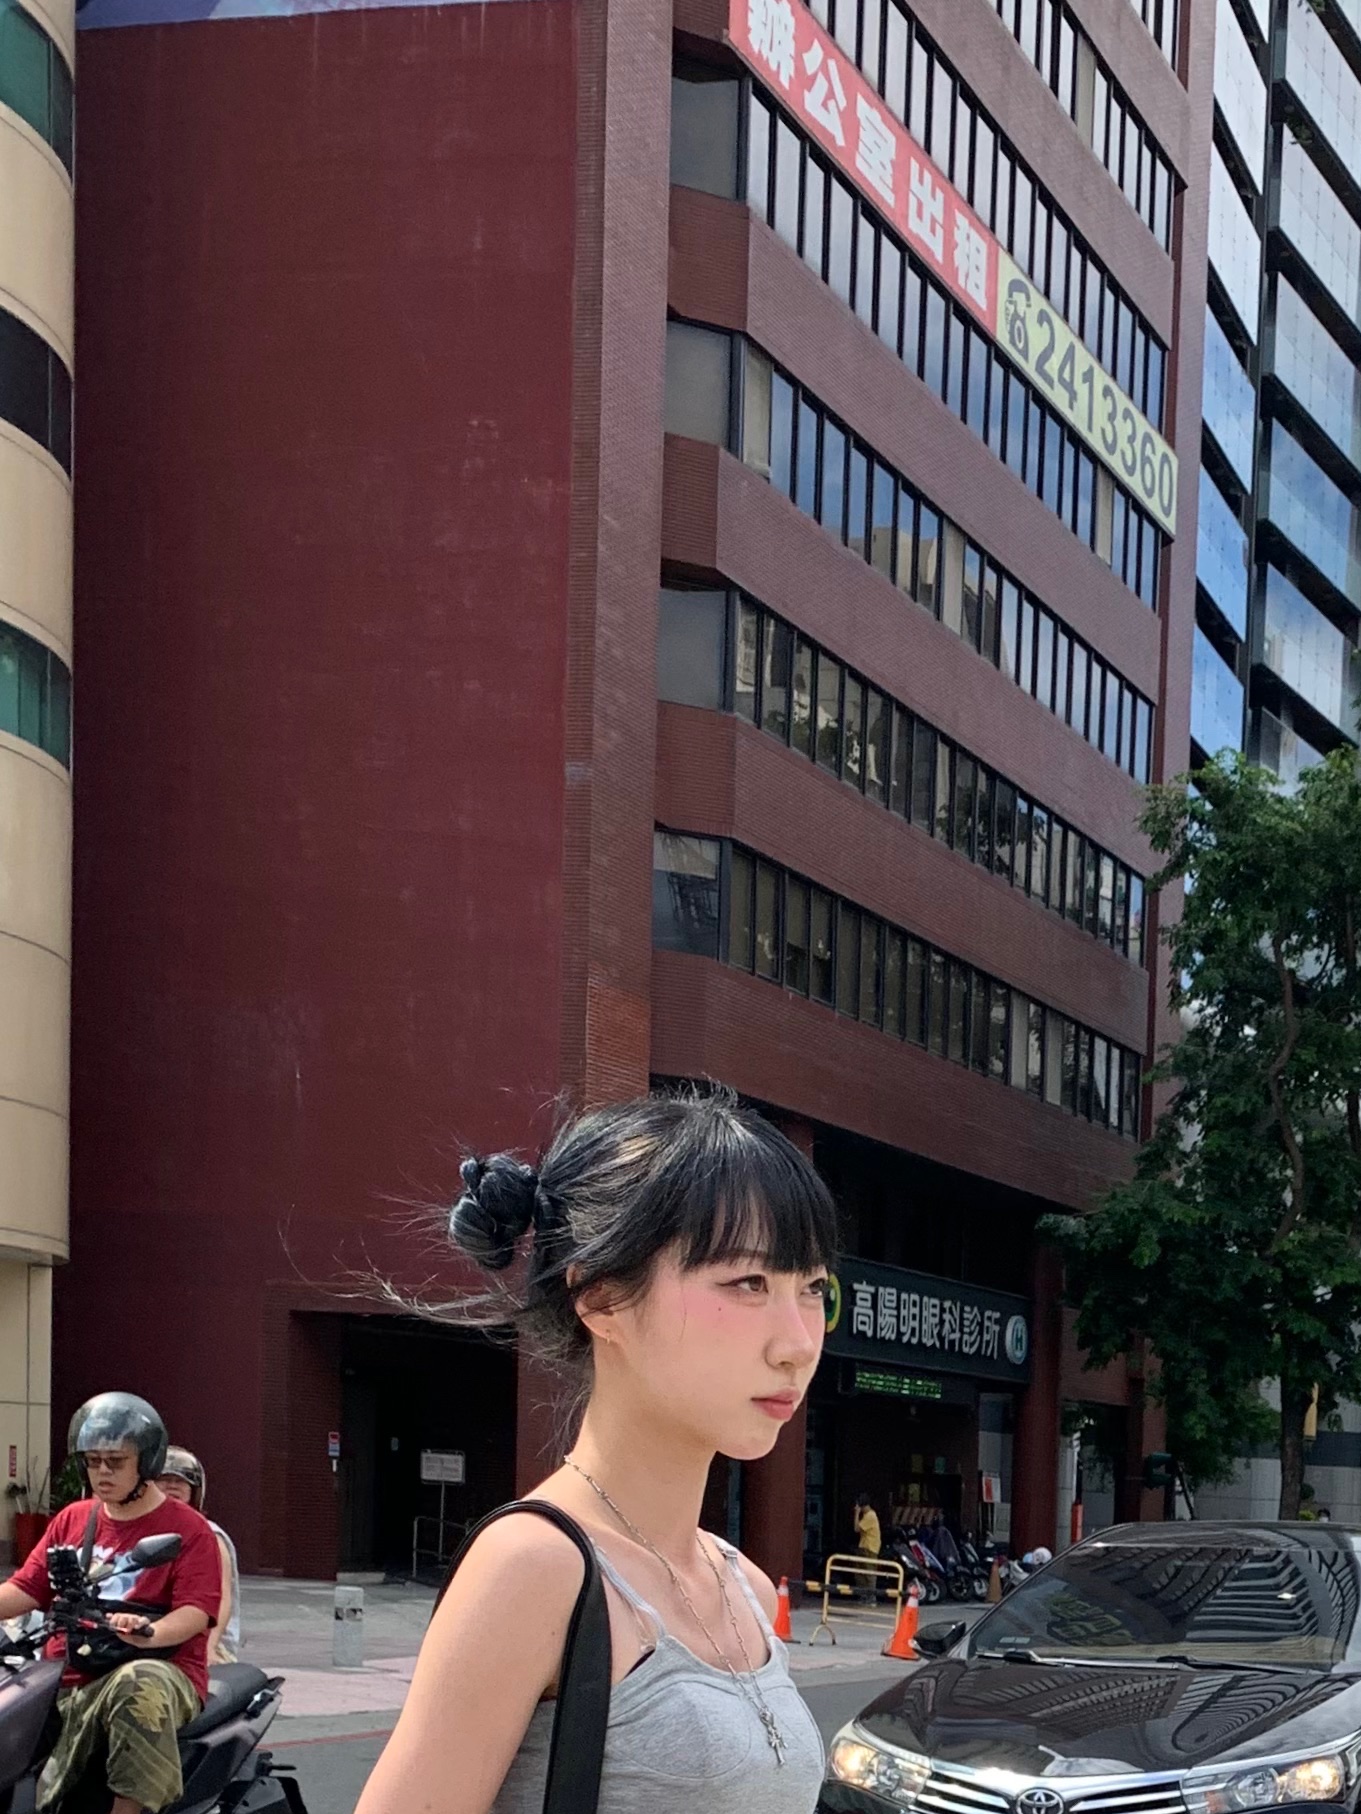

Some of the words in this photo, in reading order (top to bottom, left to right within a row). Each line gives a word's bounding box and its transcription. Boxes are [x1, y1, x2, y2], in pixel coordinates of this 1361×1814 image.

[1035, 312, 1175, 519] 2413360
[852, 1280, 1001, 1360] 高陽明眼科診所
